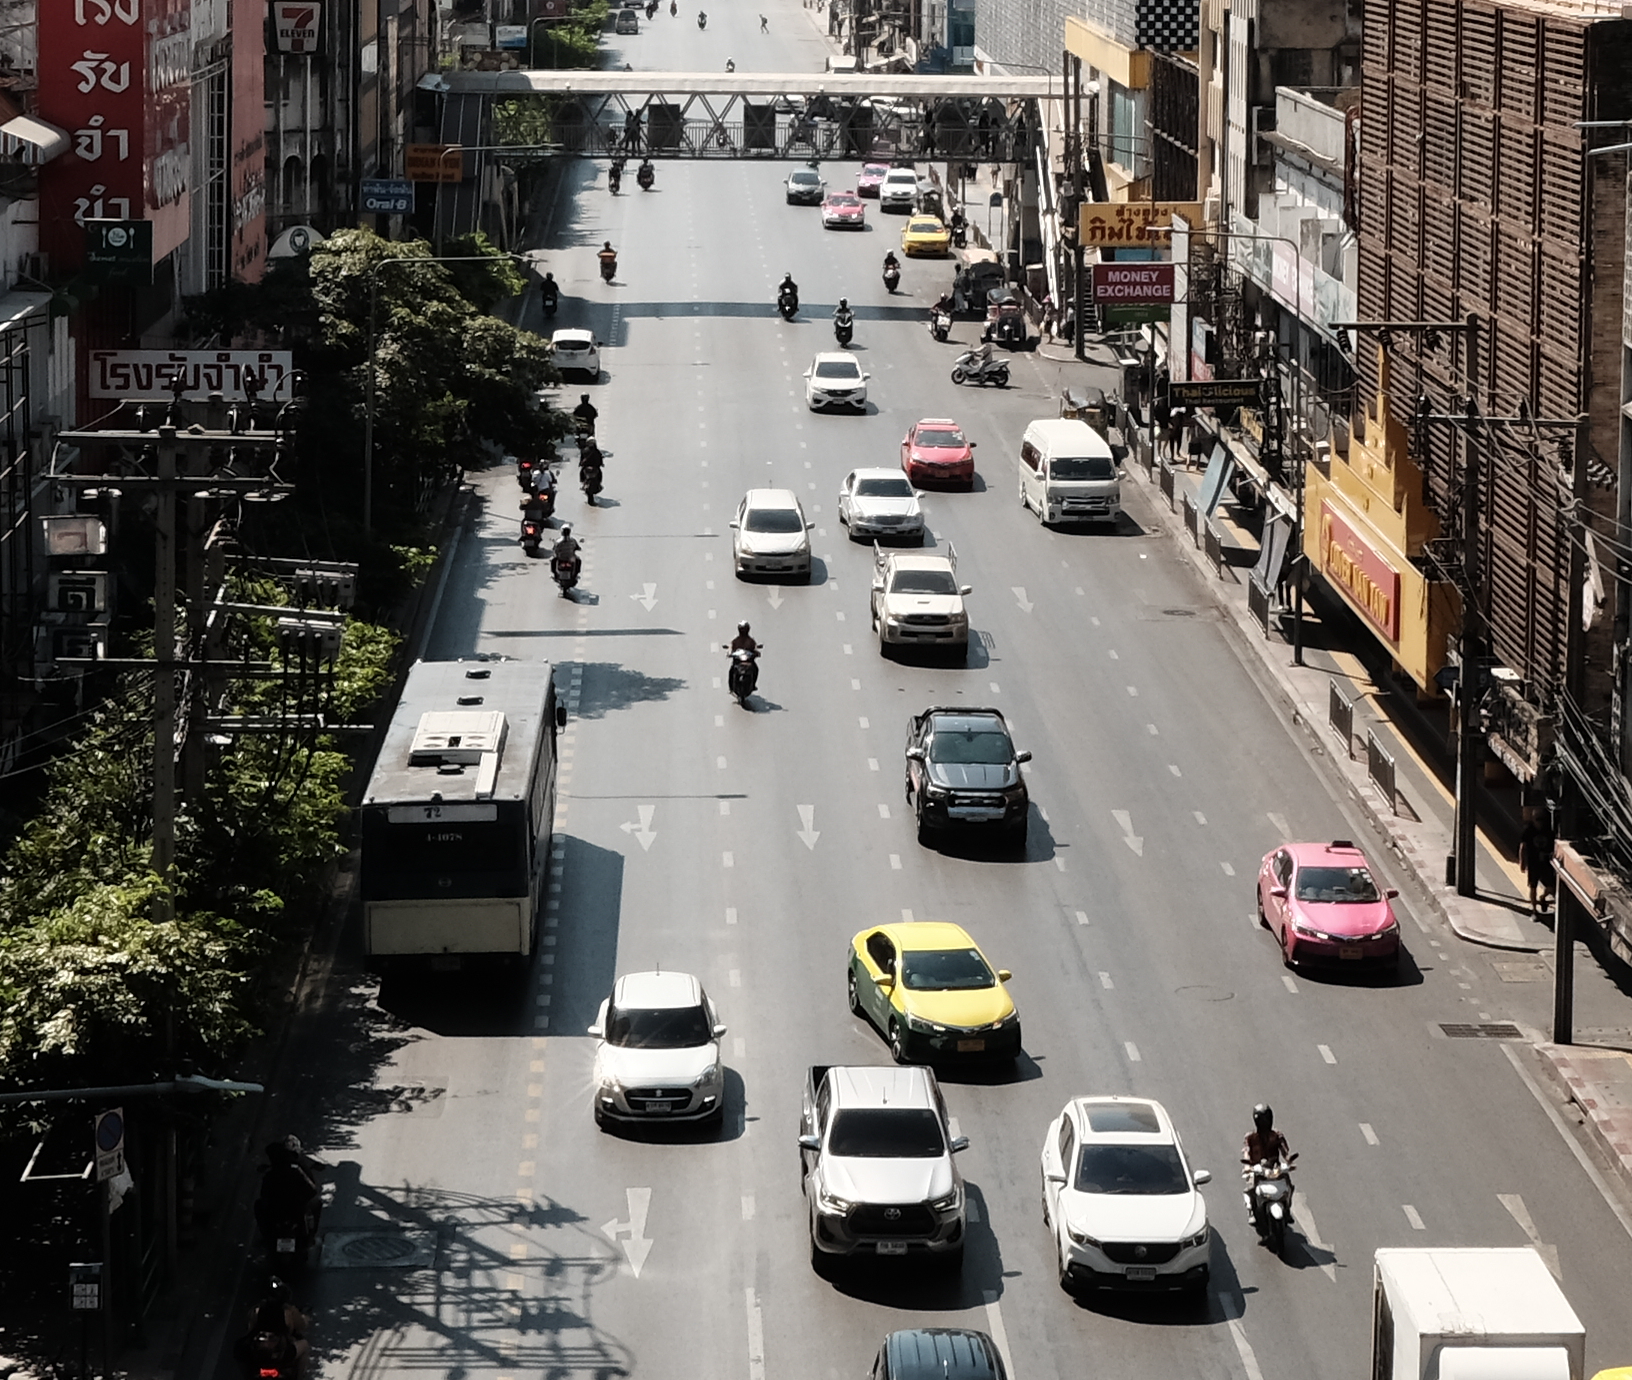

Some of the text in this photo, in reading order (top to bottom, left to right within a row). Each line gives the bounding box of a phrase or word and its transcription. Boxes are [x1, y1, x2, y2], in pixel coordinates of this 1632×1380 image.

[70, 49, 130, 94] รับ
[74, 115, 129, 162] จำ
[1096, 285, 1171, 297] EXCHANGE
[1107, 271, 1159, 283] MONEY
[93, 352, 284, 391] โรงรับจำนำ
